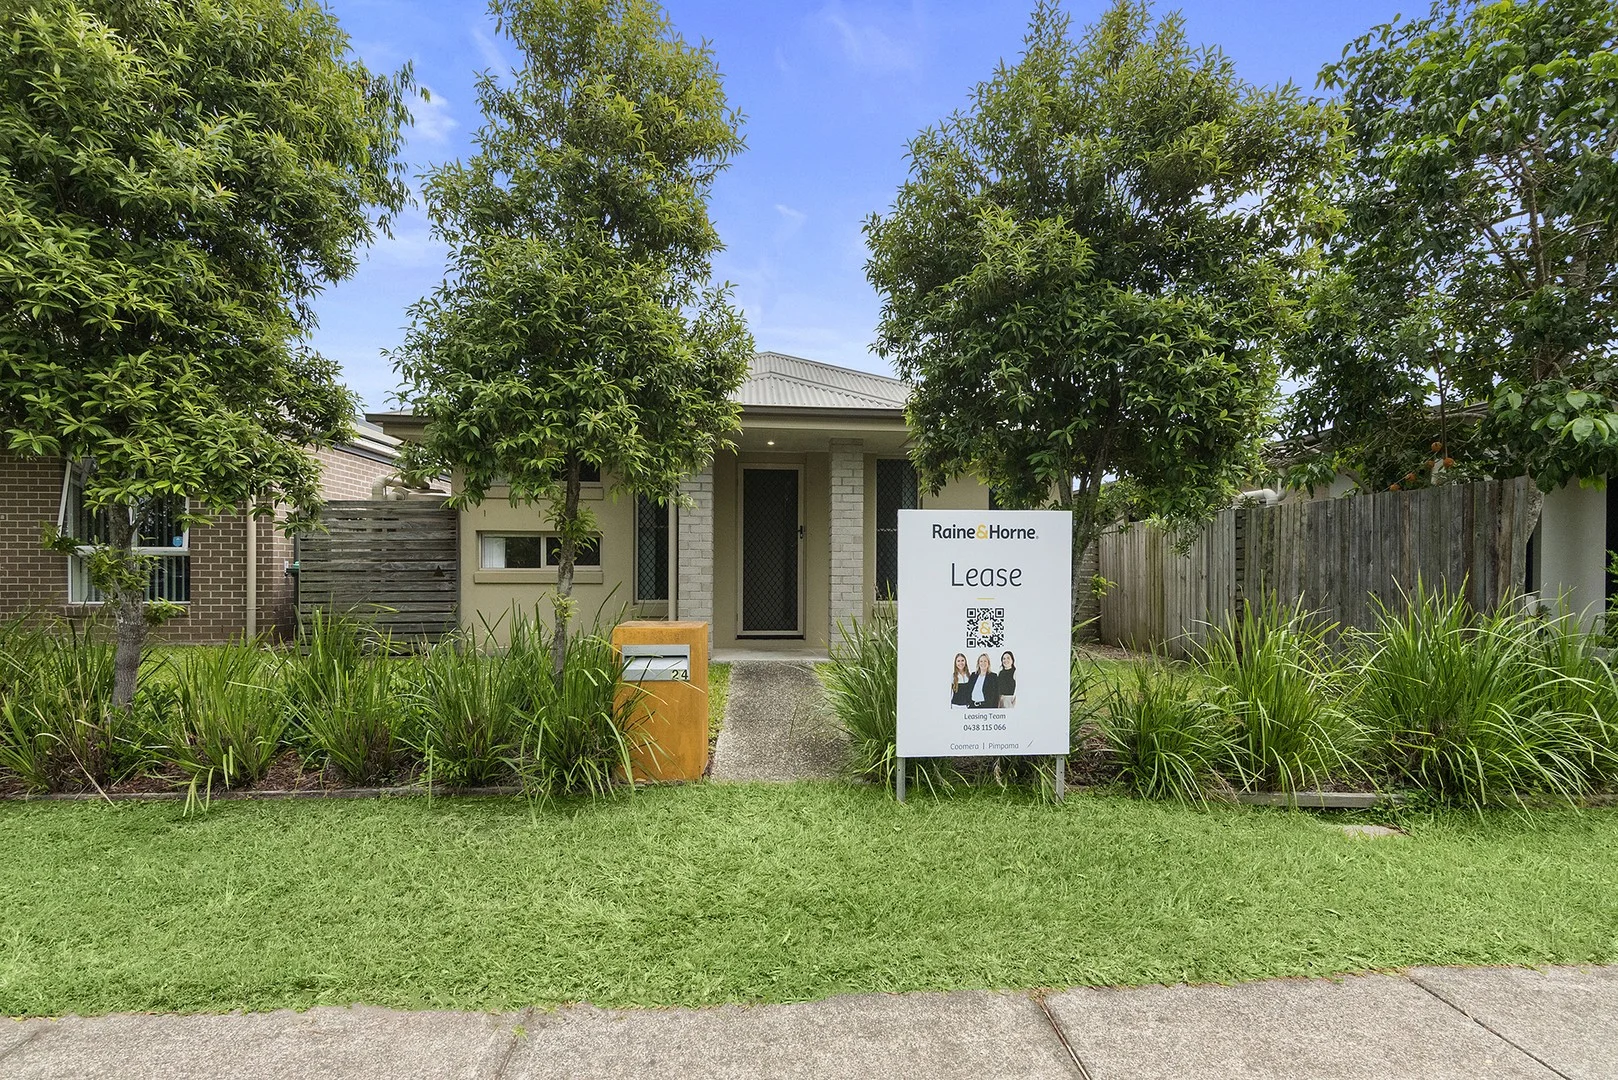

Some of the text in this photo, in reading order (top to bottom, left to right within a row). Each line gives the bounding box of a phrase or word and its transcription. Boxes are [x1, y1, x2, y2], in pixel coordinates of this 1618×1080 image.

[951, 562, 1022, 587] Lease
[671, 669, 689, 680] 24
[964, 713, 988, 721] Leasing
[963, 724, 981, 732] 0438
[950, 742, 1019, 751] Coomera Pimpama
